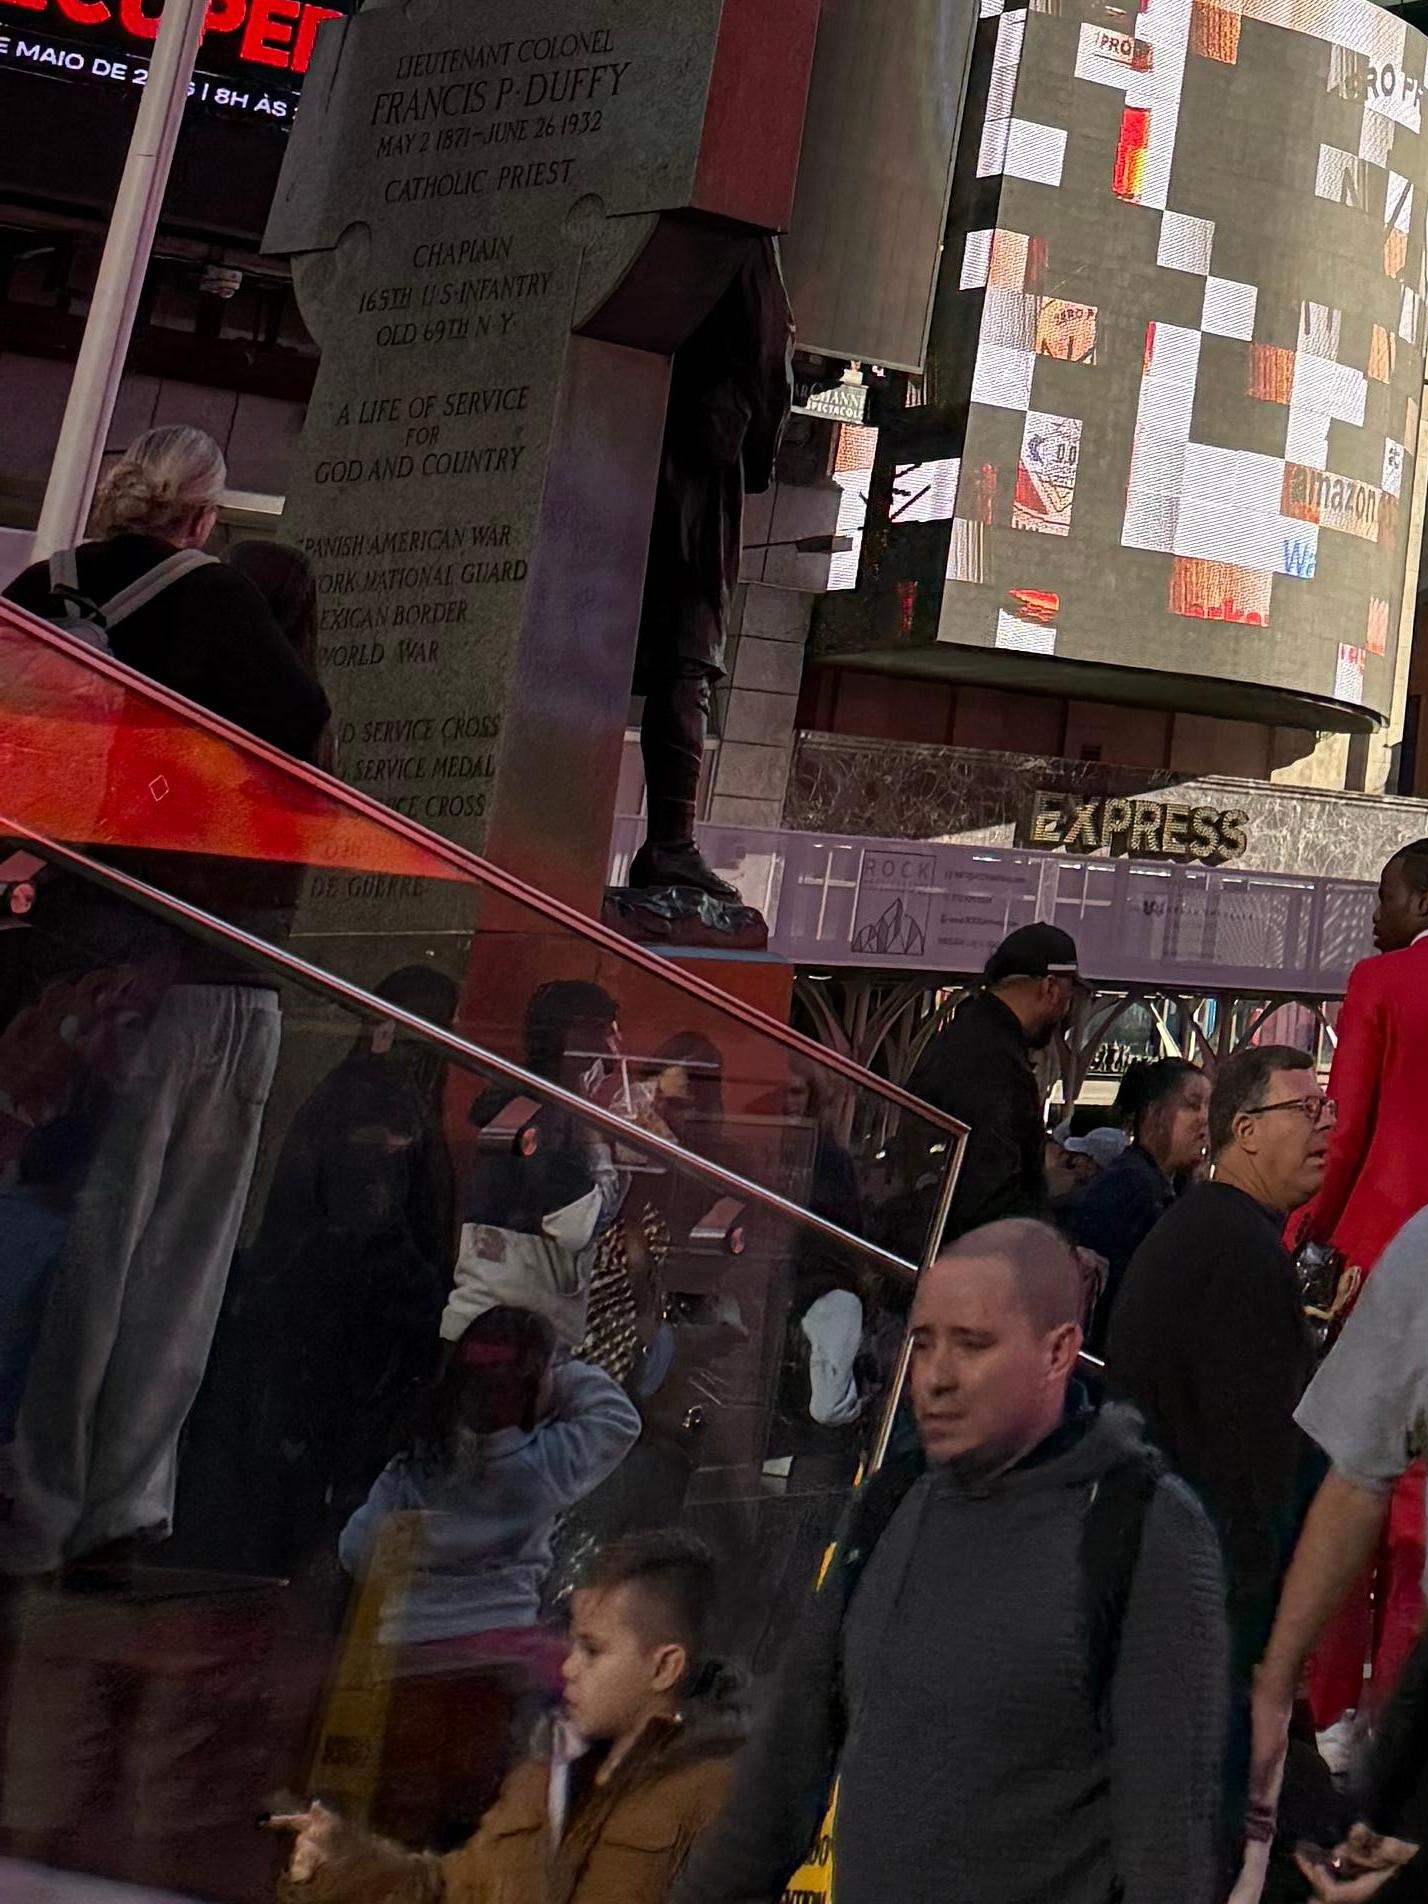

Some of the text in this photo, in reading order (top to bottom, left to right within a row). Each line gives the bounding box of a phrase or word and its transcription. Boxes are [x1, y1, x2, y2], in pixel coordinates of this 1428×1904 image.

[16, 41, 84, 70] MAIO
[92, 58, 127, 82] DE
[396, 29, 615, 80] LIEUTENANT COLONEL
[214, 87, 249, 109] 8H
[254, 92, 288, 118] ÀS
[371, 61, 632, 126] FRANCIS DUFFY
[376, 110, 603, 159] MAY 2 26 1932
[385, 158, 577, 204] CATHOLIC PRIEST
[413, 235, 514, 269] CHAPLAIN
[359, 286, 414, 314] 165TH
[376, 312, 470, 349] OLD 69TH
[335, 386, 530, 427] A LIFE OF SERVICE
[405, 425, 440, 448] FOR
[314, 446, 526, 484] GOD AND COUNTRY
[472, 523, 512, 549] WAR
[363, 558, 529, 591] NATIONAL GUARD
[391, 599, 469, 628] BORDER
[397, 640, 439, 665] WAR
[361, 718, 437, 744] SERVICE
[441, 714, 501, 740] CROSS
[352, 752, 496, 782] SERVICE MEDAL
[424, 793, 487, 818] CROSS
[1030, 790, 1250, 862] EXPRESS
[865, 857, 932, 881] ROCK
